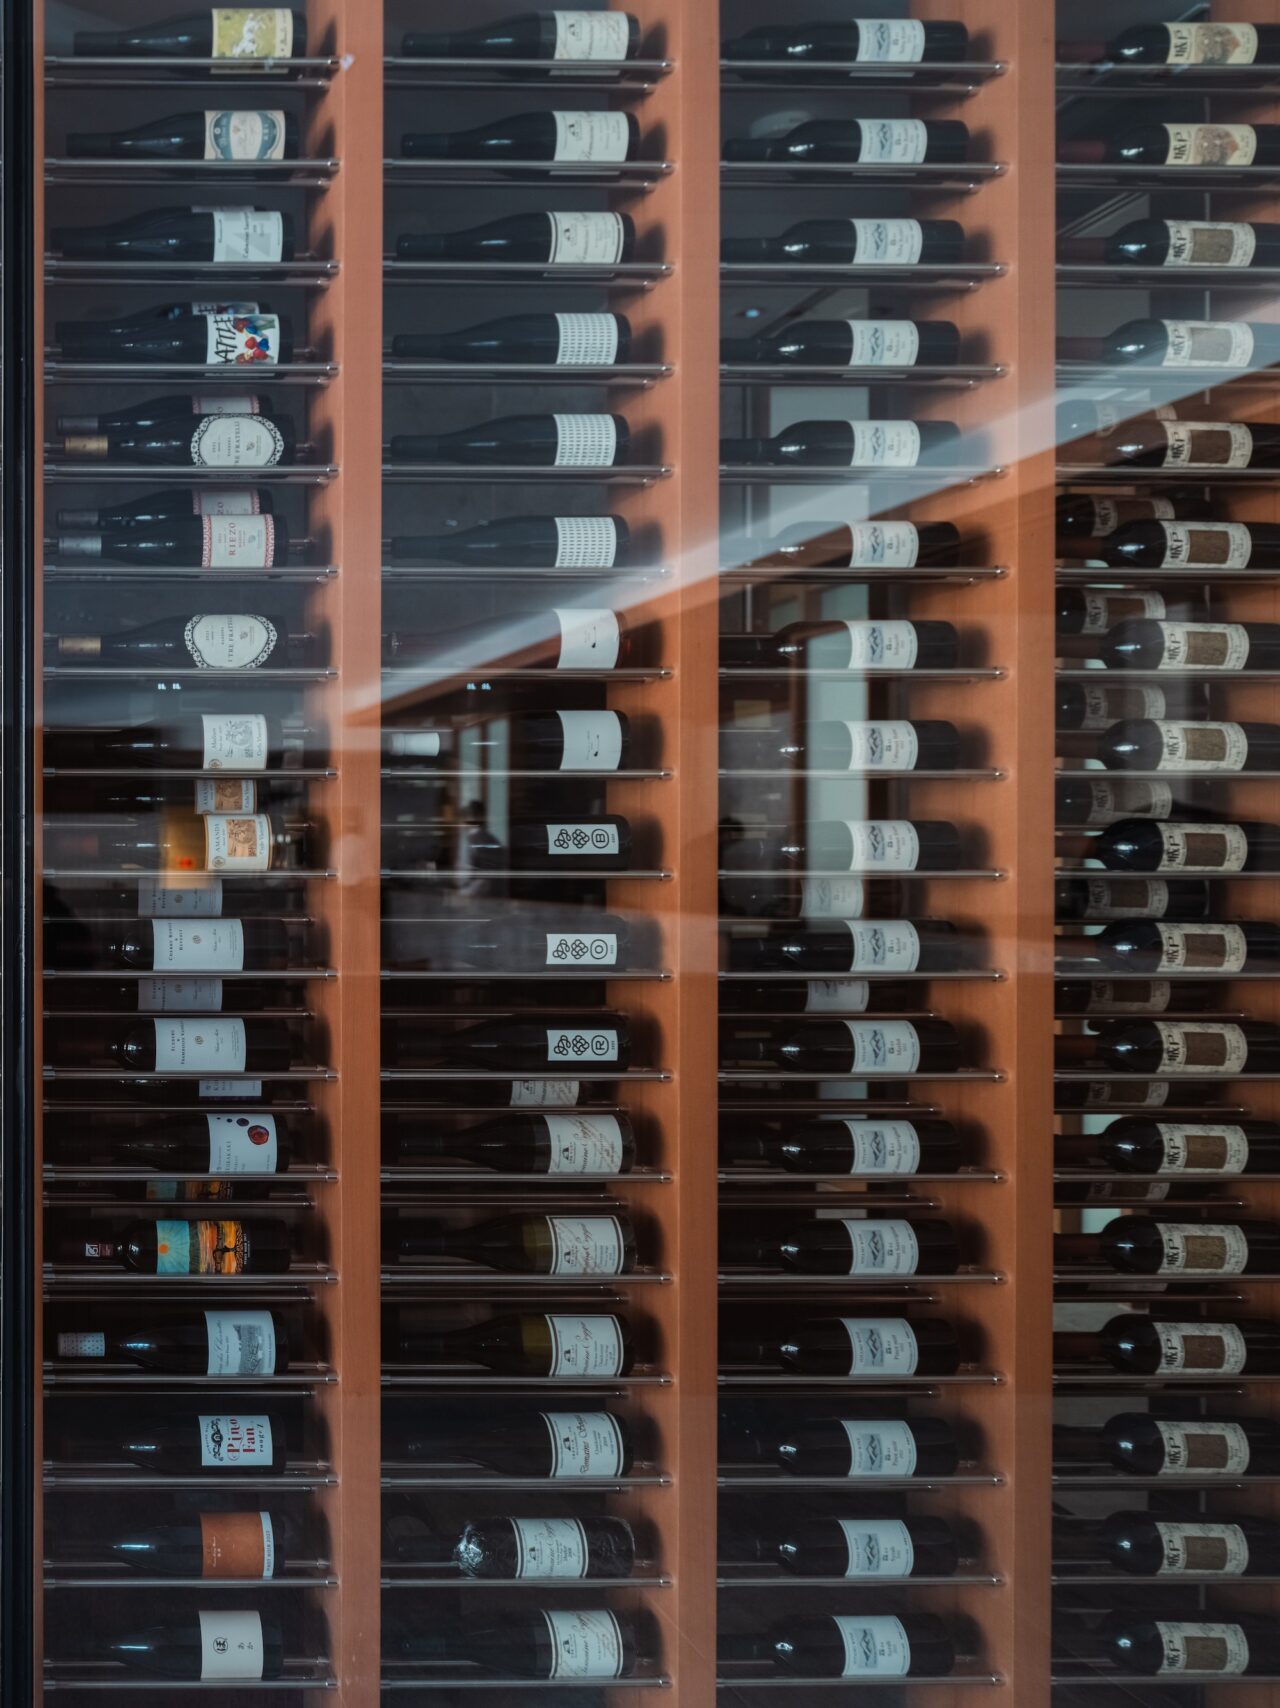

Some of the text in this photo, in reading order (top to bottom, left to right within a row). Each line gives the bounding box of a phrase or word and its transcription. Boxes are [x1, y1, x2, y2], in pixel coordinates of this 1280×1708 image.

[214, 315, 237, 364] ATTLE
[228, 522, 236, 556] RIEZO
[243, 1427, 256, 1453] Fan
[216, 1639, 227, 1651] ほ
